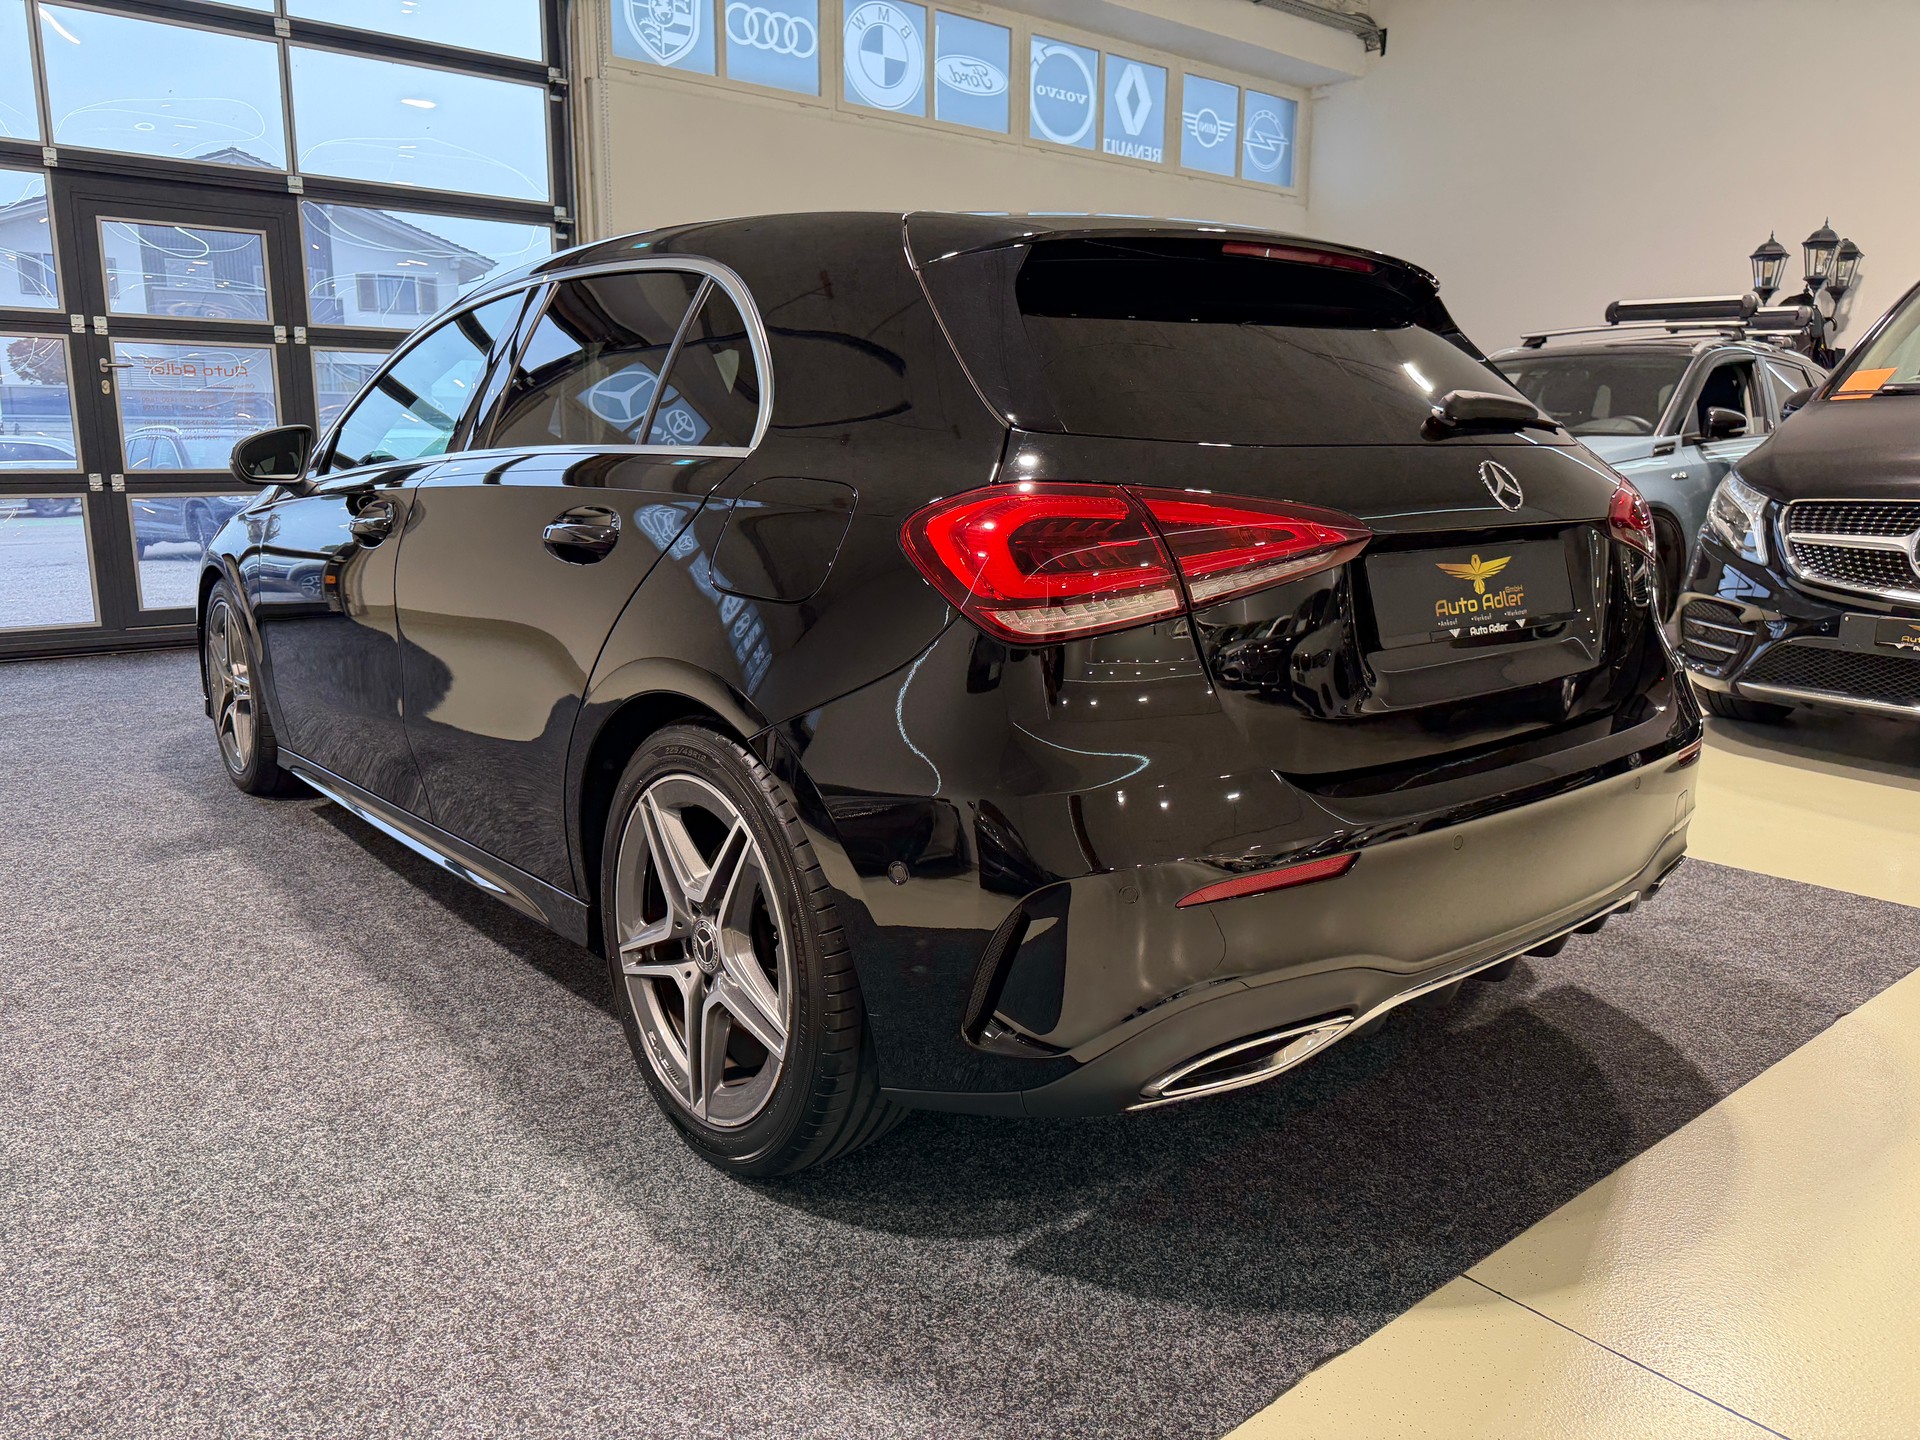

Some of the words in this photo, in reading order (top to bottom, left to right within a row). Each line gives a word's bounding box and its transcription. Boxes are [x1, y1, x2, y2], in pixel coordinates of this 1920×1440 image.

[1505, 584, 1523, 593] GmbH
[1435, 597, 1478, 616] Auto
[1482, 591, 1525, 610] Adler
[1469, 626, 1488, 636] Auto
[1489, 622, 1509, 633] Adler
